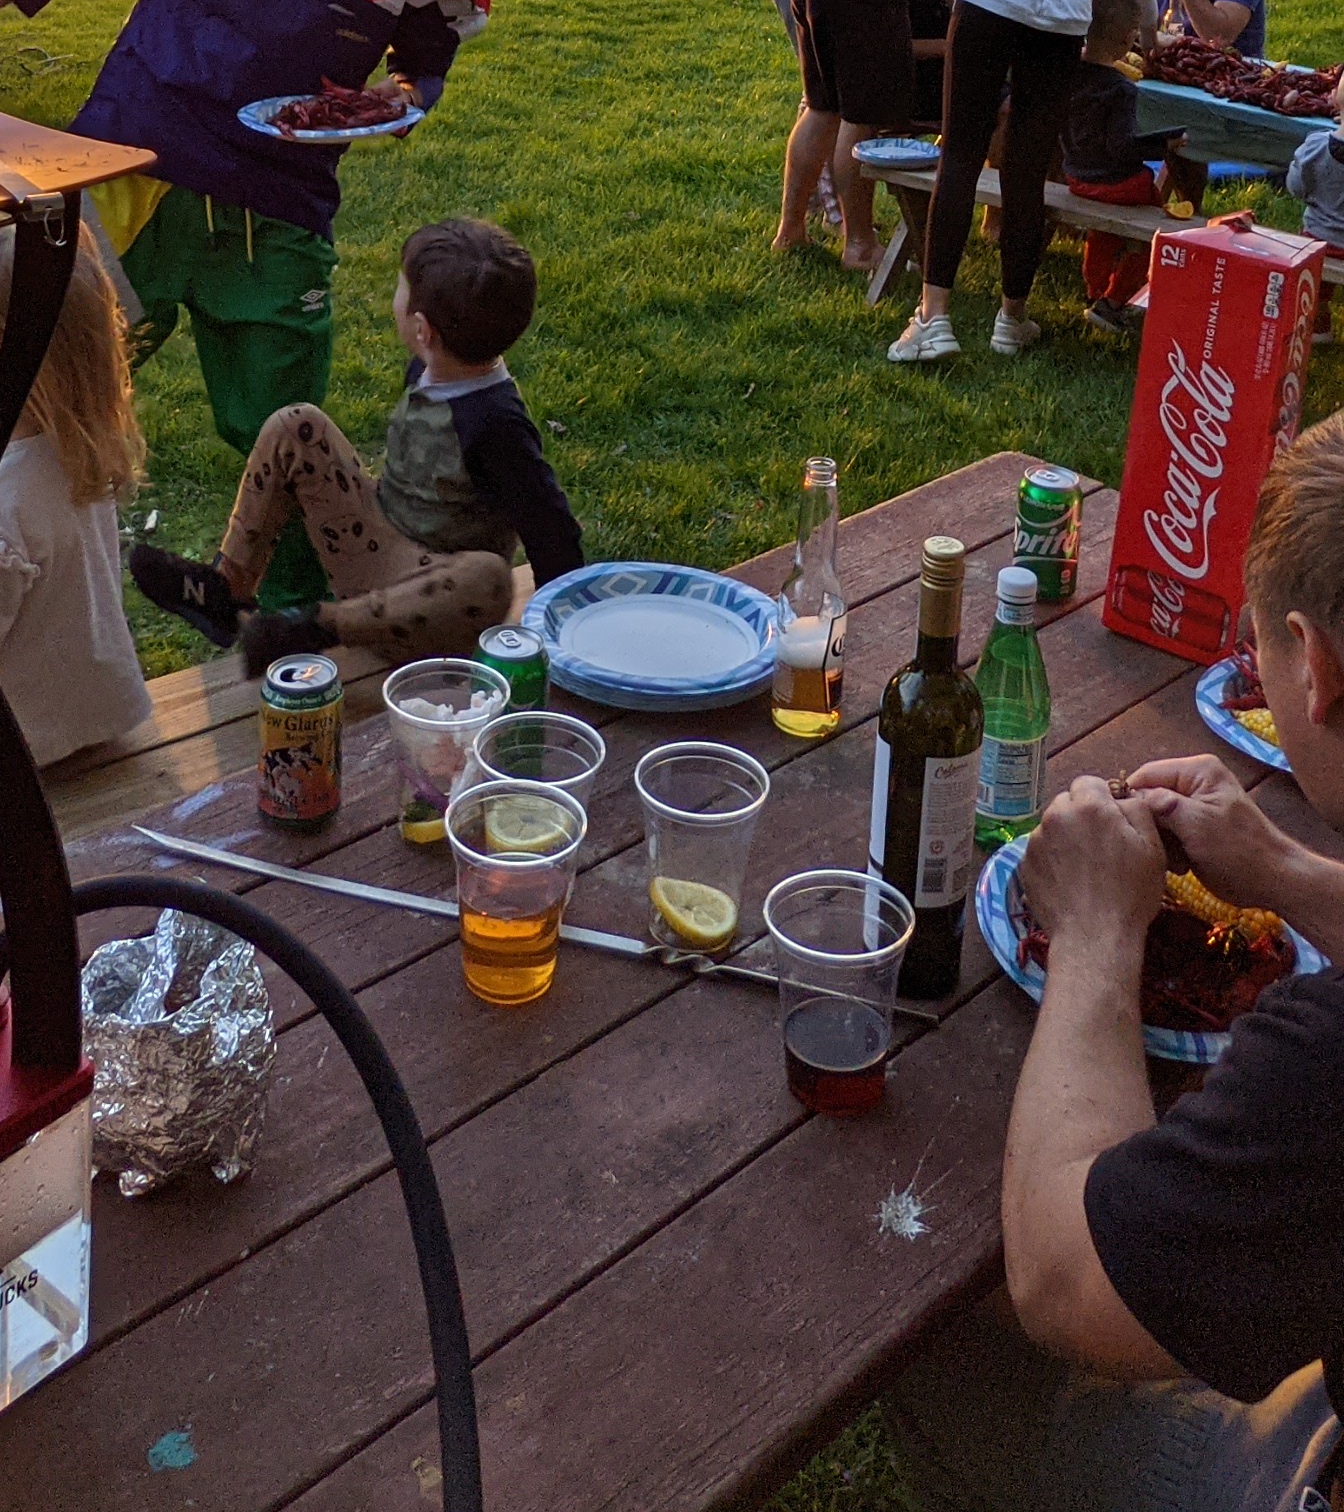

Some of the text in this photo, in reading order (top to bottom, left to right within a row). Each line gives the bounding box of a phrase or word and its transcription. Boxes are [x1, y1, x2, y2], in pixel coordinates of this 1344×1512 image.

[1161, 244, 1180, 267] 12
[1202, 256, 1226, 359] ORIGINAL TASTE
